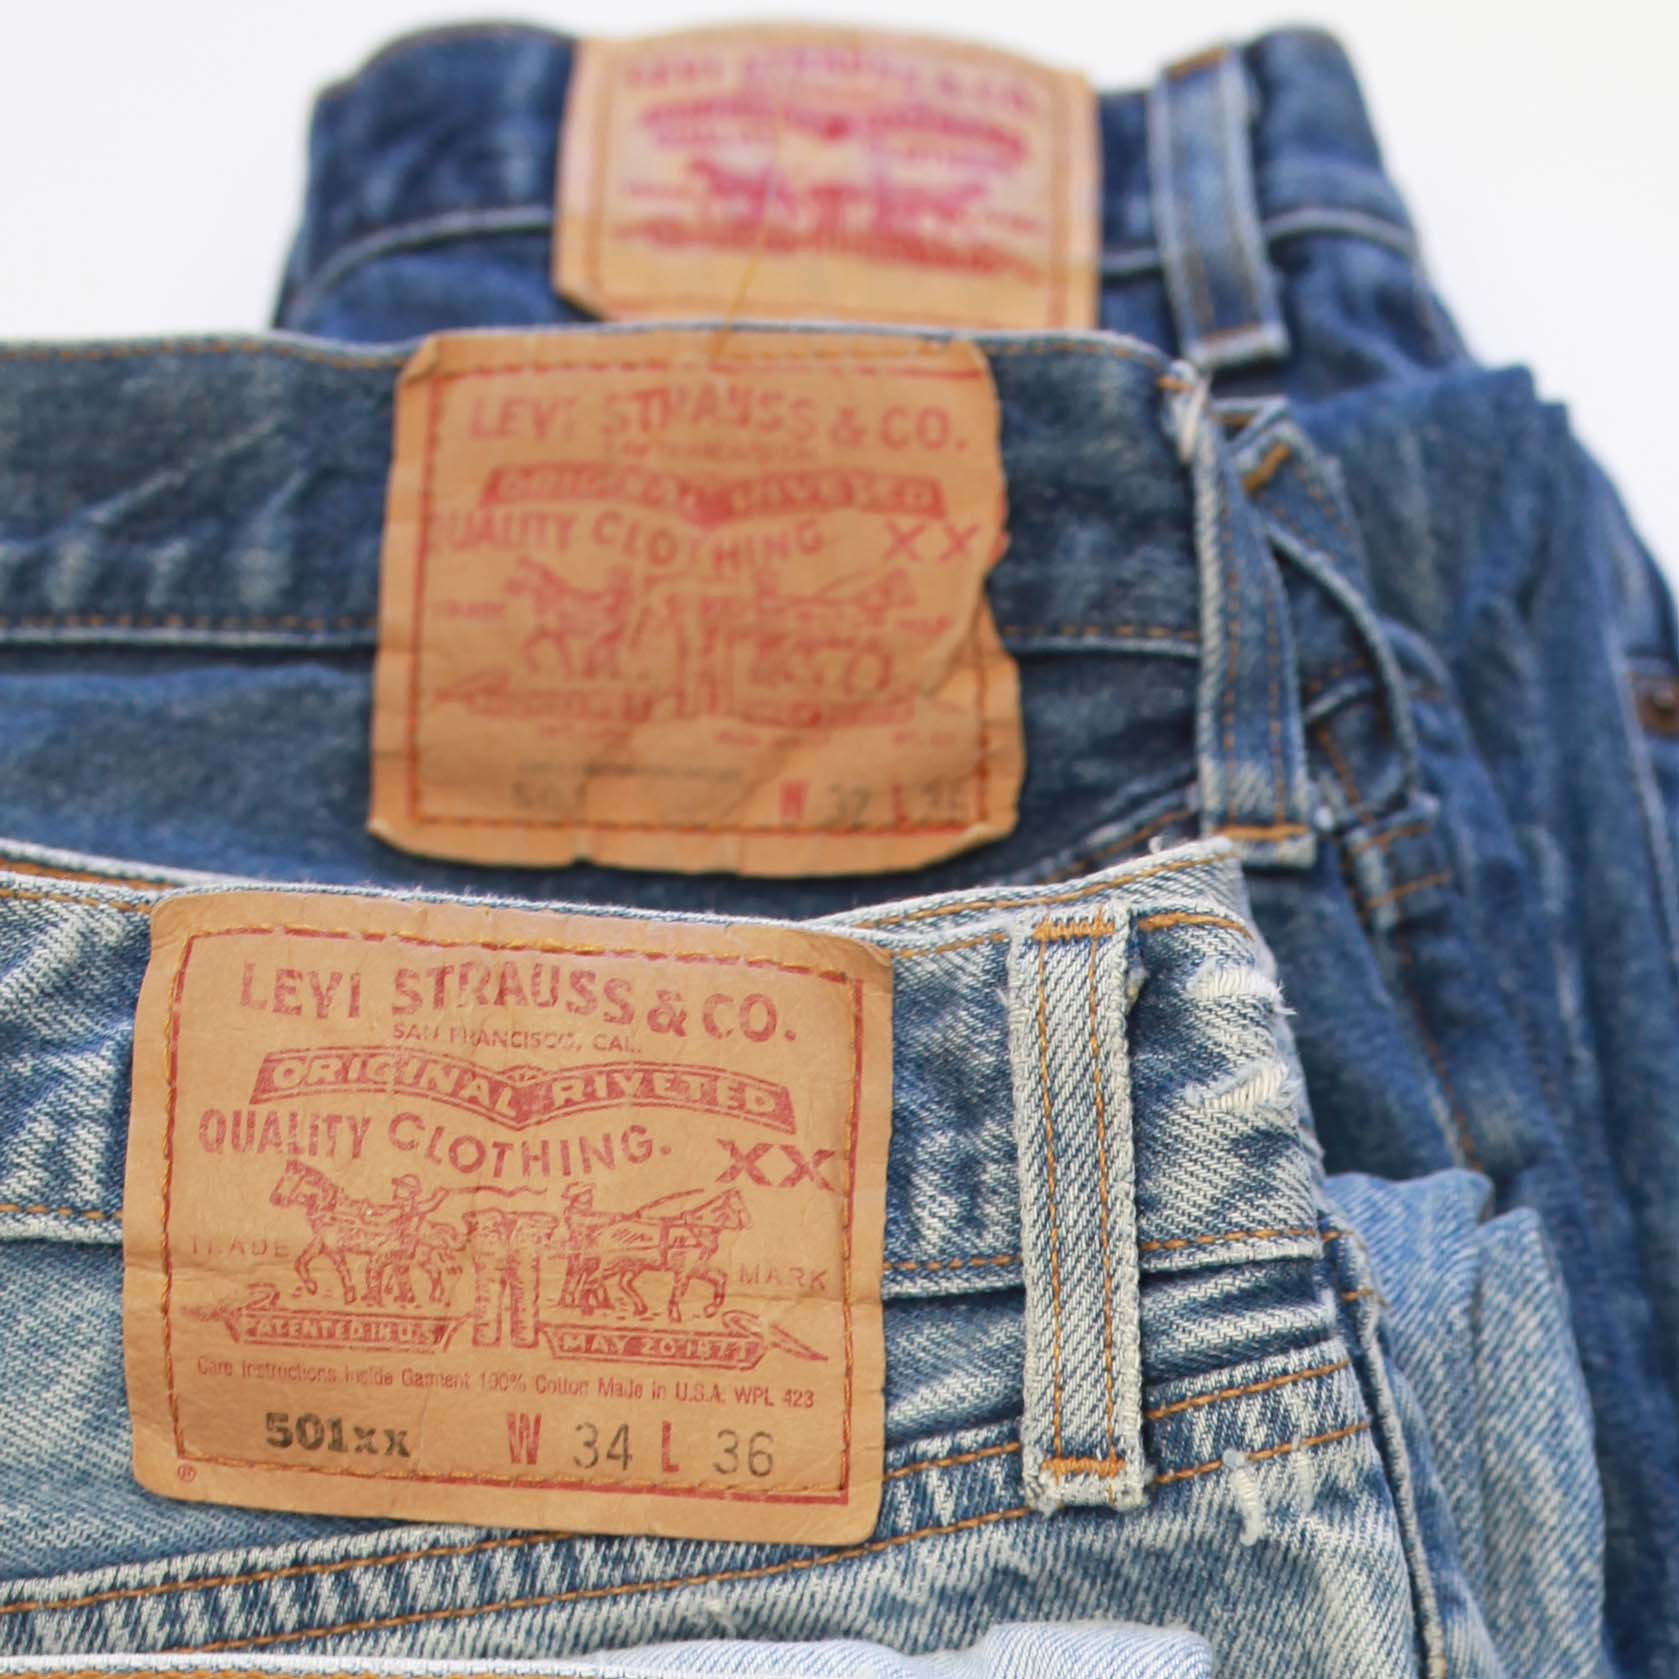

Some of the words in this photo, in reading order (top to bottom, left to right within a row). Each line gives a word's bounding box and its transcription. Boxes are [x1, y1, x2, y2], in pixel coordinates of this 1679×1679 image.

[240, 963, 361, 1019] LEVI
[391, 960, 635, 1025] STRAUSS
[646, 989, 688, 1037] &
[702, 992, 797, 1043] CO.
[271, 1052, 517, 1117] ORIGINAL
[552, 1070, 779, 1113] RIVETED
[198, 1107, 371, 1160] QUALITY
[387, 1111, 672, 1179] CLOTHING.
[734, 1386, 775, 1408] WPL
[505, 1411, 542, 1466] W
[572, 1421, 633, 1472] 34
[660, 1420, 681, 1473] L
[713, 1428, 775, 1478] 36
